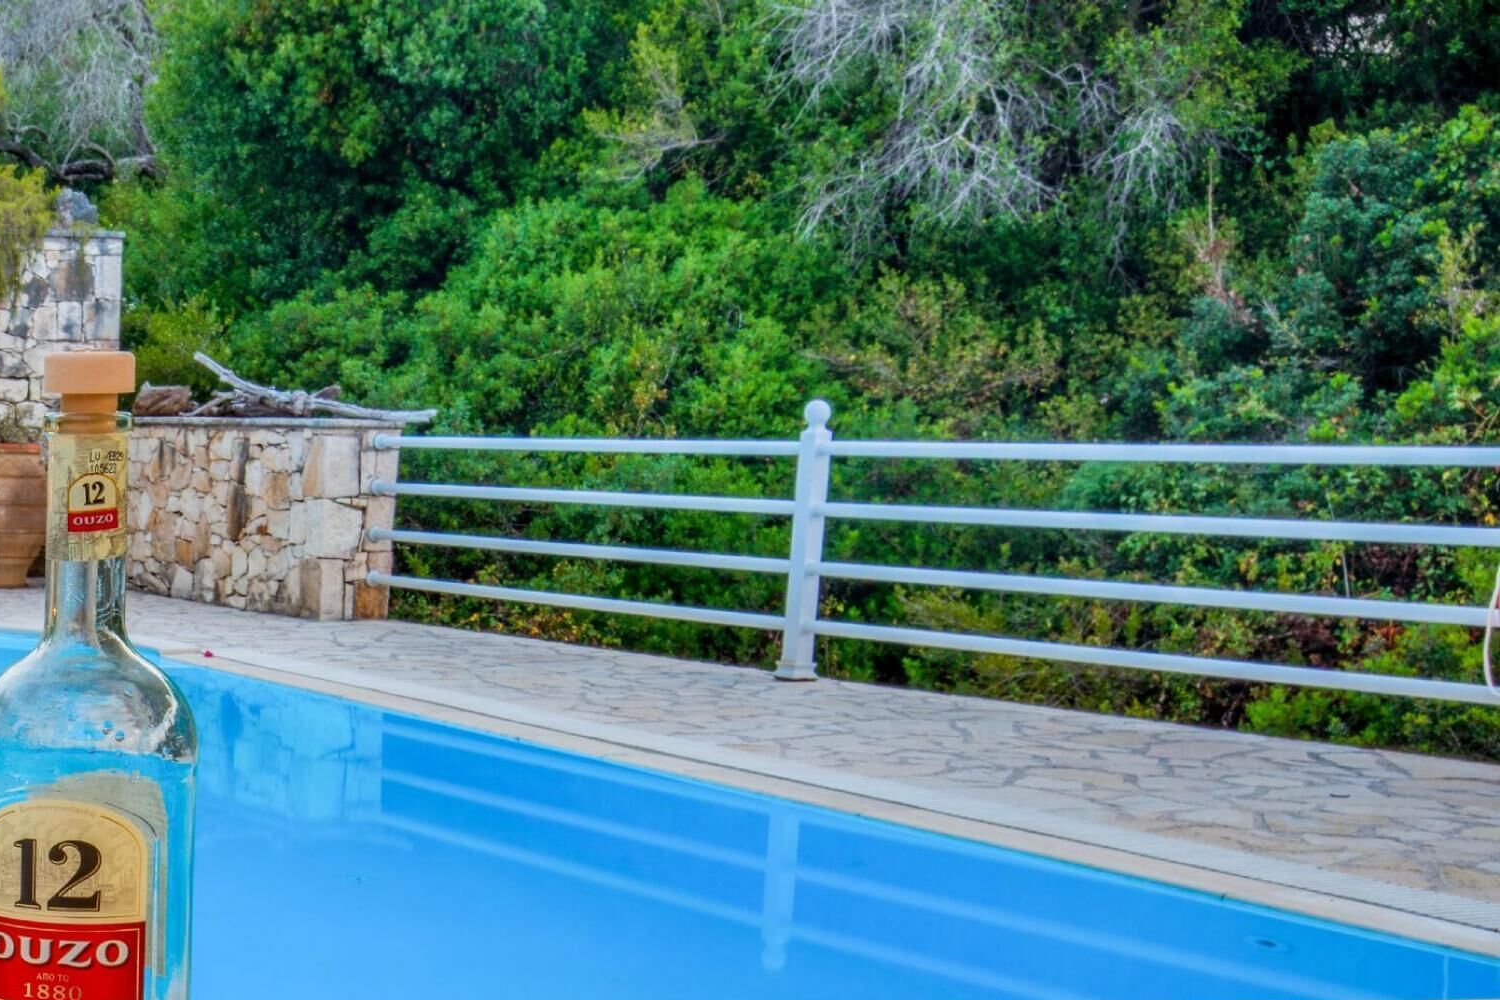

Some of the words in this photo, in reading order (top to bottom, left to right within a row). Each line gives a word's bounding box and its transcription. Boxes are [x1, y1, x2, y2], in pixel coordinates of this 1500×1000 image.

[82, 481, 106, 506] 12
[72, 513, 114, 527] OUZO
[13, 838, 102, 912] 12
[23, 982, 83, 1000] 1880
